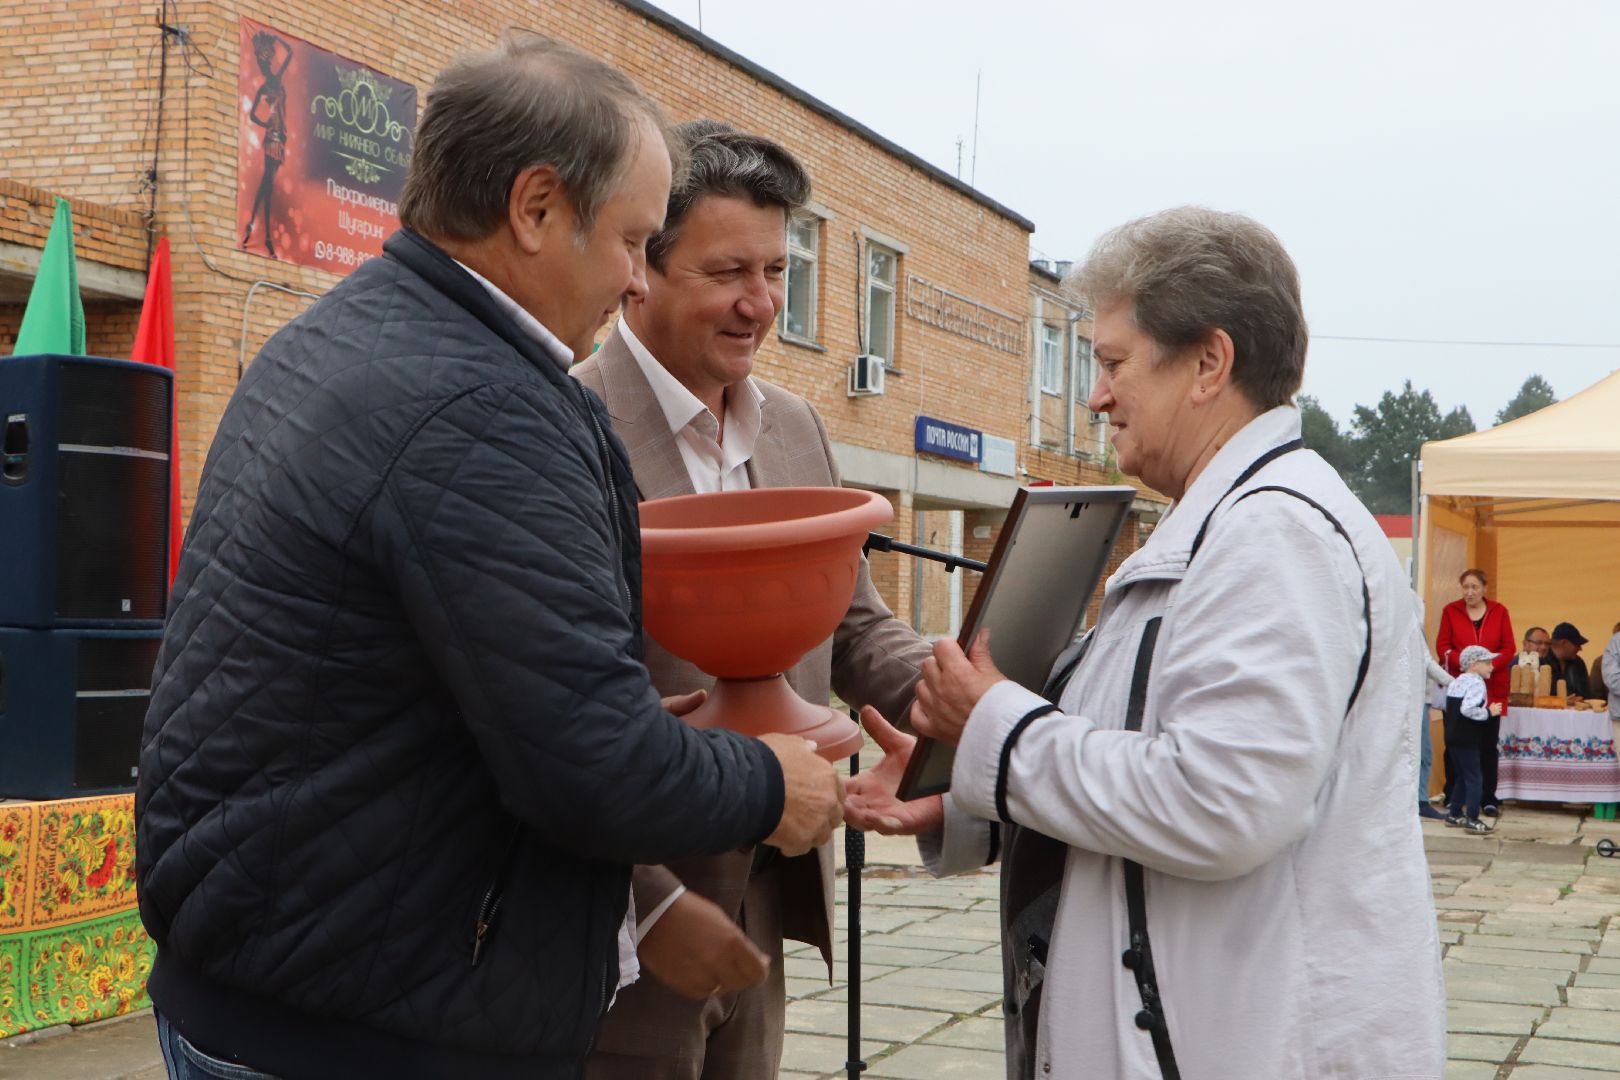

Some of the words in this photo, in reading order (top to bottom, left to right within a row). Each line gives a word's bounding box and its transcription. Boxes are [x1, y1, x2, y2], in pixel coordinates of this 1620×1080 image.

[313, 122, 336, 141] МИР
[339, 129, 380, 158] НИЖНЕГО
[338, 209, 384, 240] Шугаринг
[926, 424, 946, 447] ПОЧТА
[947, 429, 970, 453] РОССИИ
